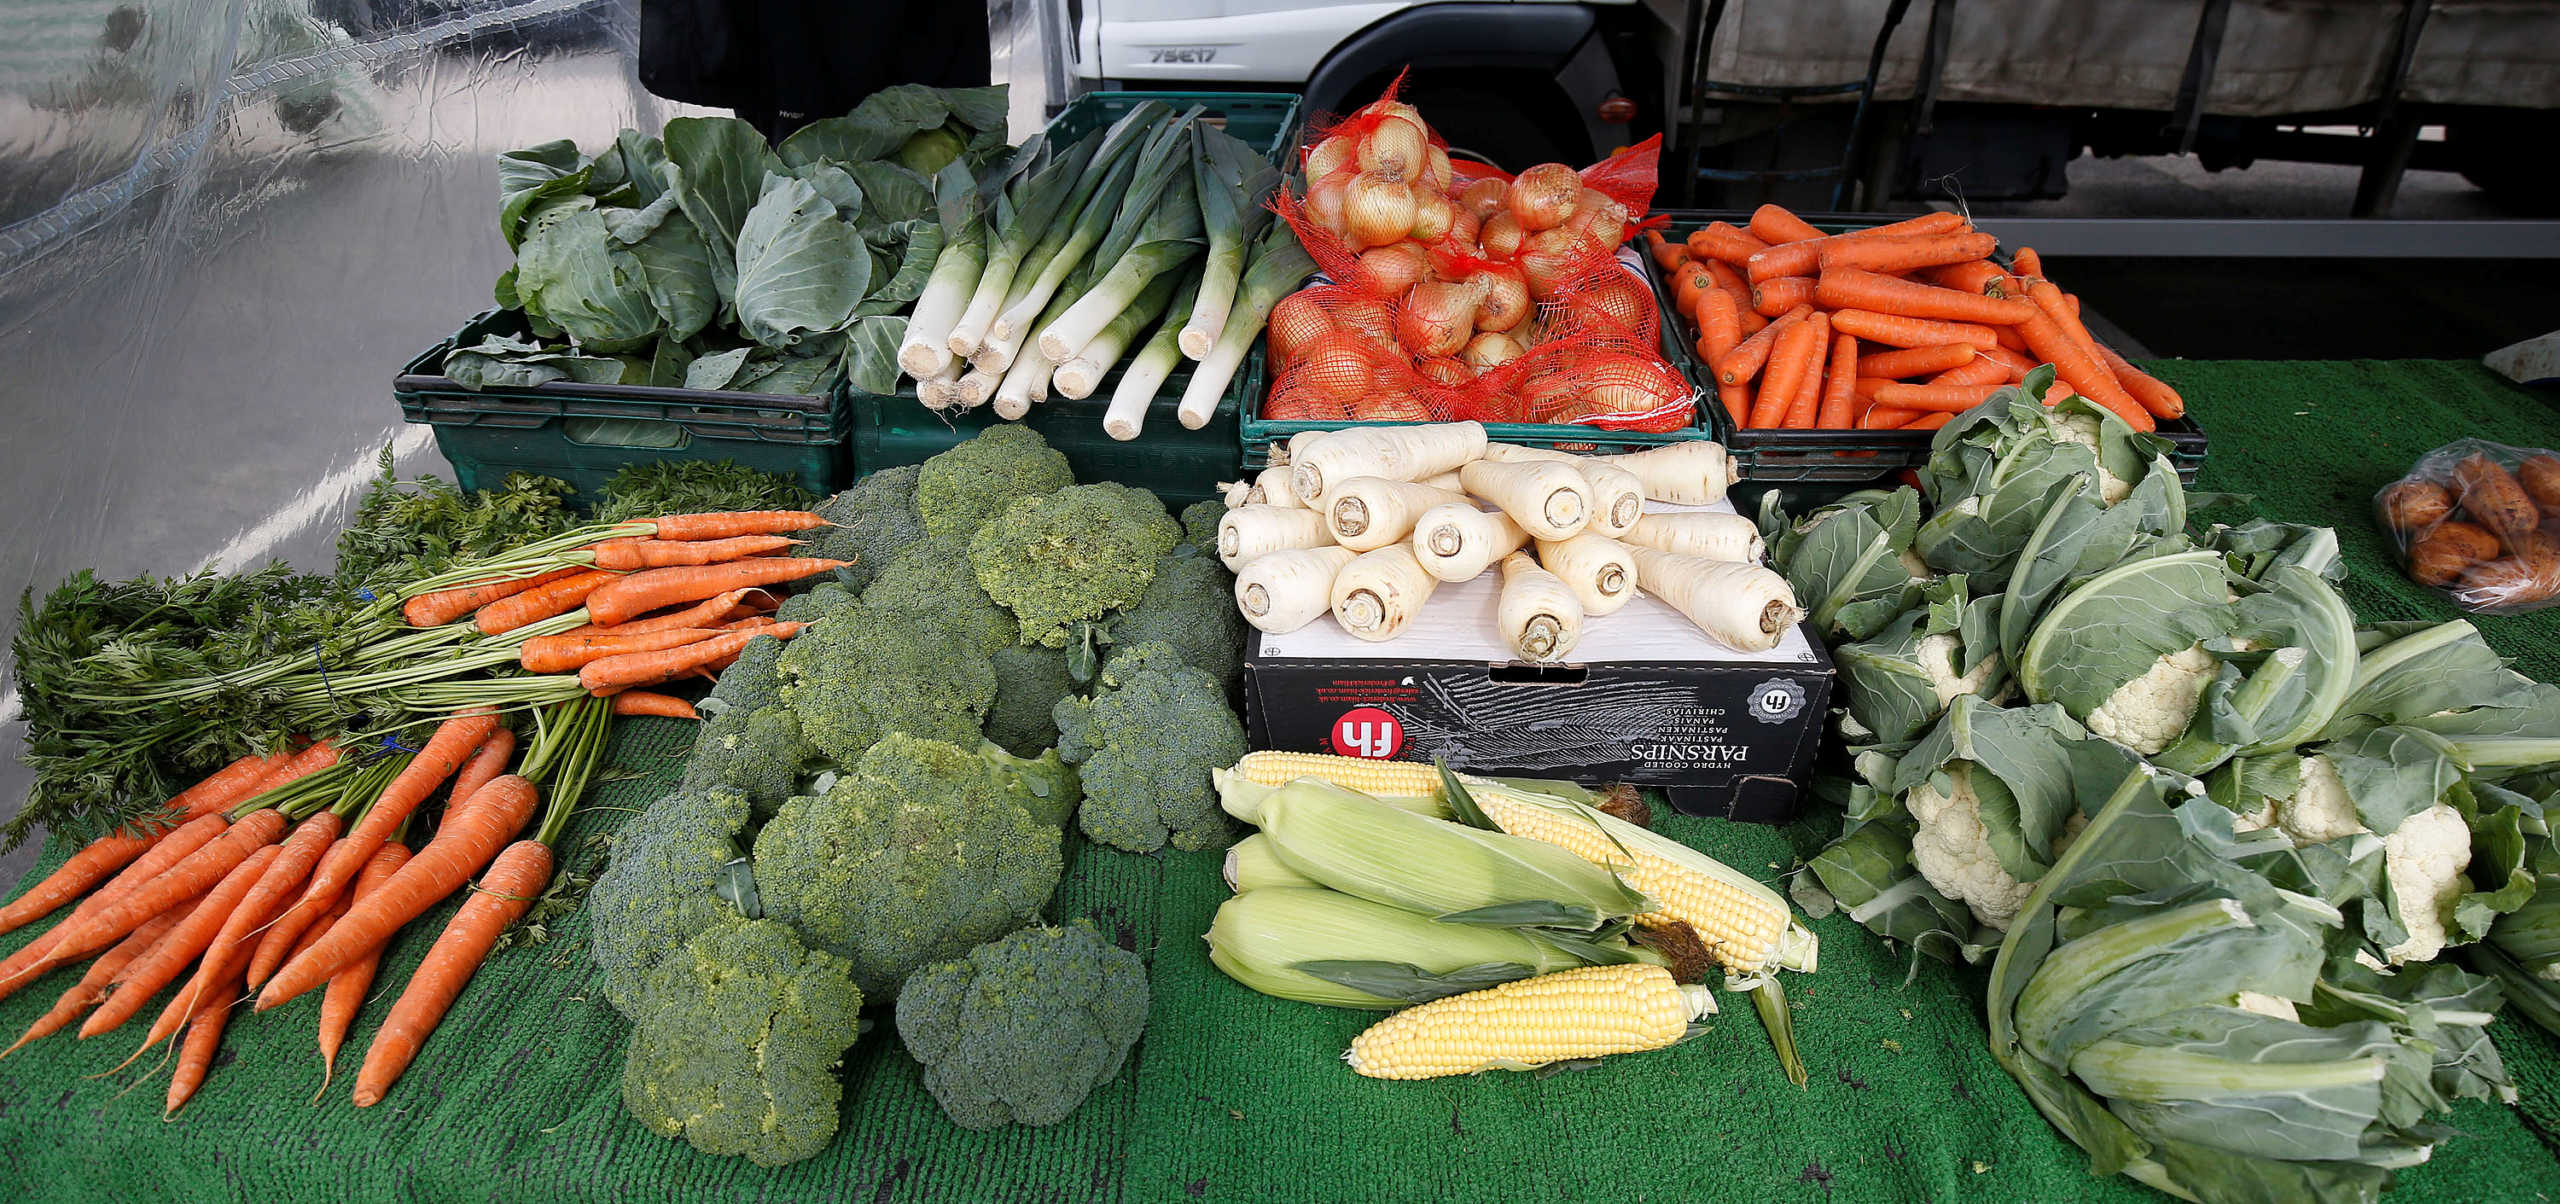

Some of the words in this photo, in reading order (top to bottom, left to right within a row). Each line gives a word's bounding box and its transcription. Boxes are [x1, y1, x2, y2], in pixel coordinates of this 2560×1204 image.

[1766, 695, 1787, 710] fh
[1674, 717, 1715, 725] PANAIS
[1658, 726, 1728, 734] PASTINAKEN
[1342, 721, 1393, 757] fh
[1660, 735, 1723, 743] PASTINAAK
[1631, 744, 1750, 761] PARSNIPS
[1643, 761, 1689, 769] COOLED
